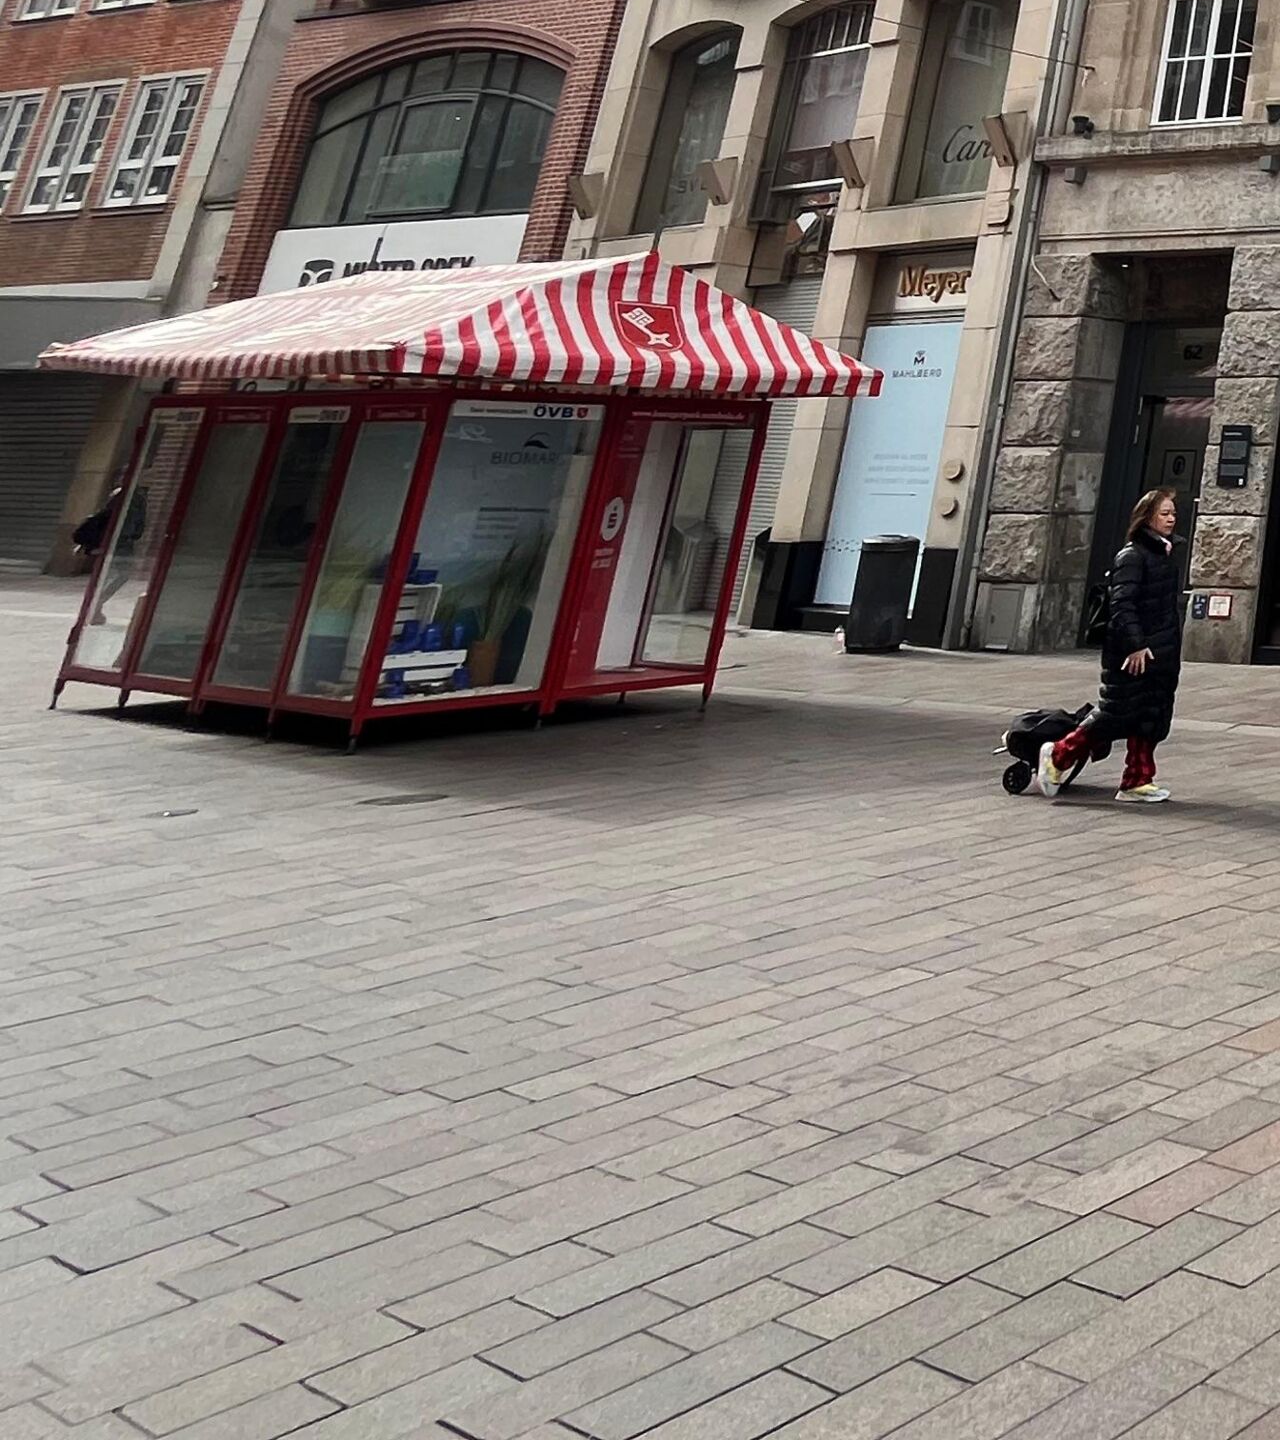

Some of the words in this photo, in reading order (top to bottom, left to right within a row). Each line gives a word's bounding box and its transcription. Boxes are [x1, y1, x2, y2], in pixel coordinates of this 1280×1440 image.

[899, 263, 972, 304] Meyer
[1184, 344, 1203, 360] 62
[892, 368, 943, 378] MAHLBERG
[533, 404, 574, 419] ÖVB
